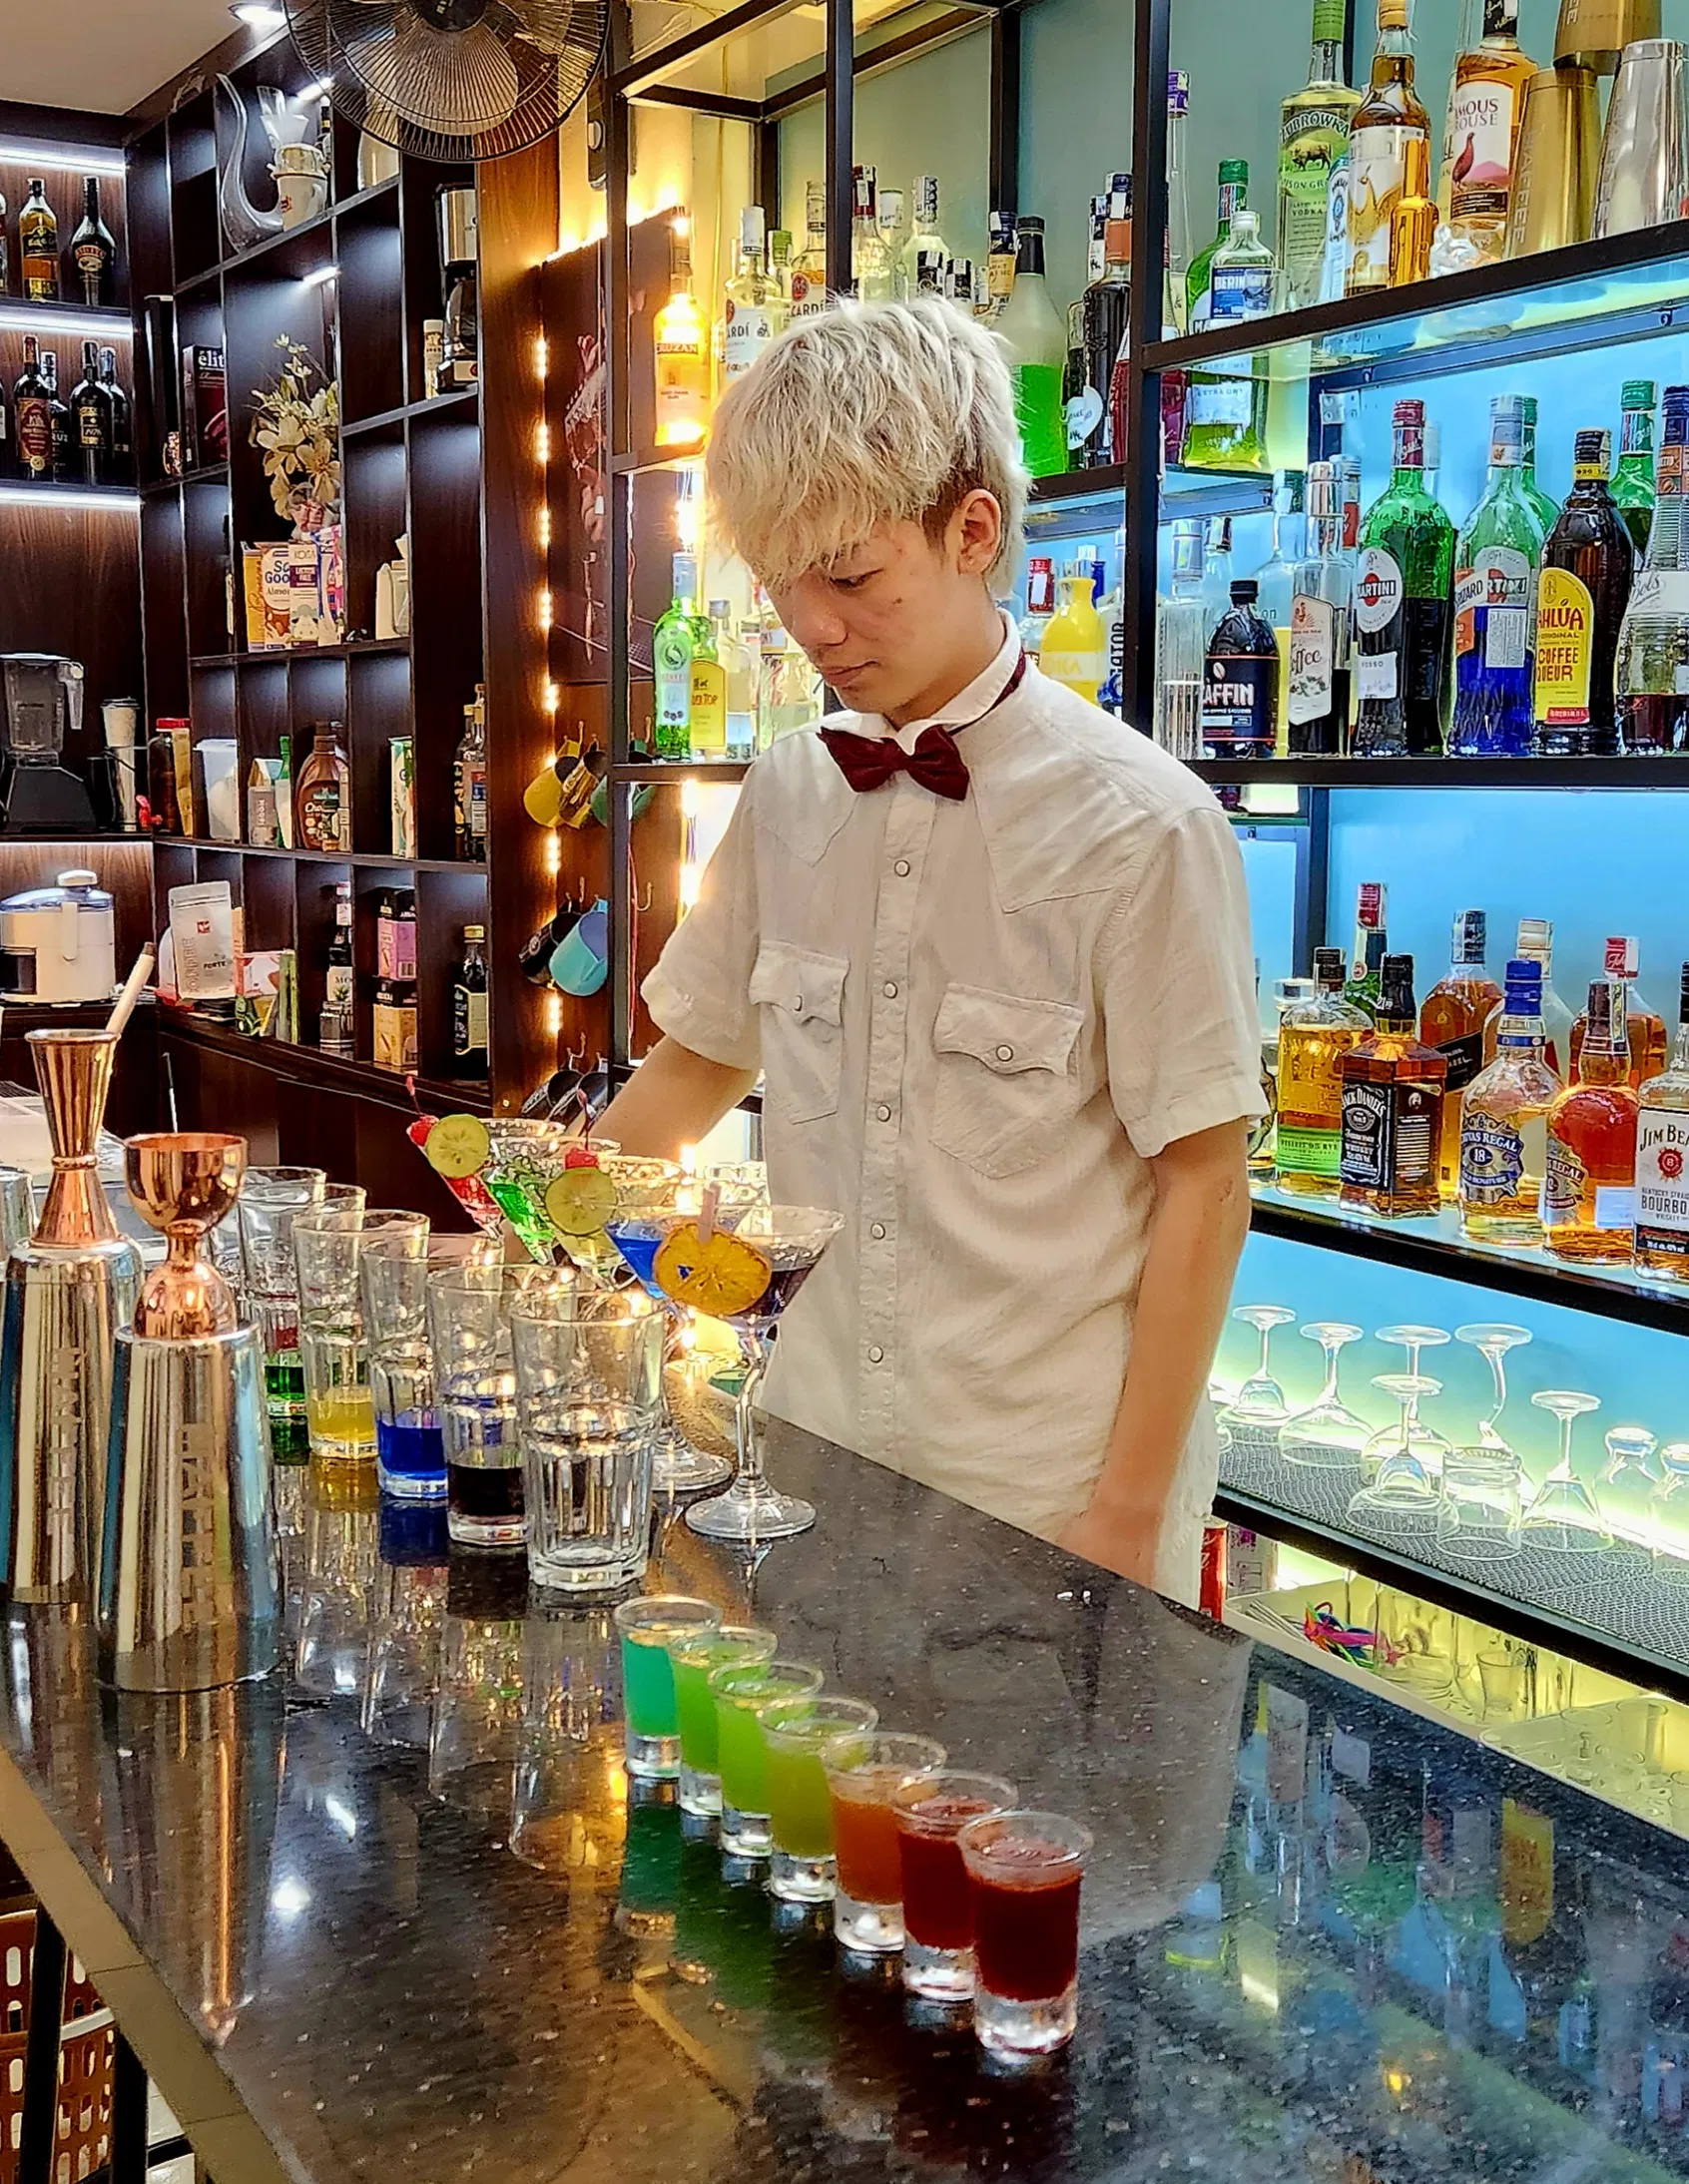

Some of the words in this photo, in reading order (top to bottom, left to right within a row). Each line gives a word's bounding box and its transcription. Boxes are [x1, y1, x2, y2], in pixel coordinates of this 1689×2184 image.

[1487, 576, 1527, 595] RTINI
[1261, 608, 1278, 621] on
[1538, 647, 1579, 665] COFFEE
[1447, 1056, 1472, 1069] ABEL
[1482, 1132, 1518, 1153] REGAL
[1640, 1126, 1665, 1152] JIM
[1473, 1149, 1486, 1163] 18
[1551, 1160, 1582, 1182] REGAL
[1641, 1195, 1689, 1215] BOURBO
